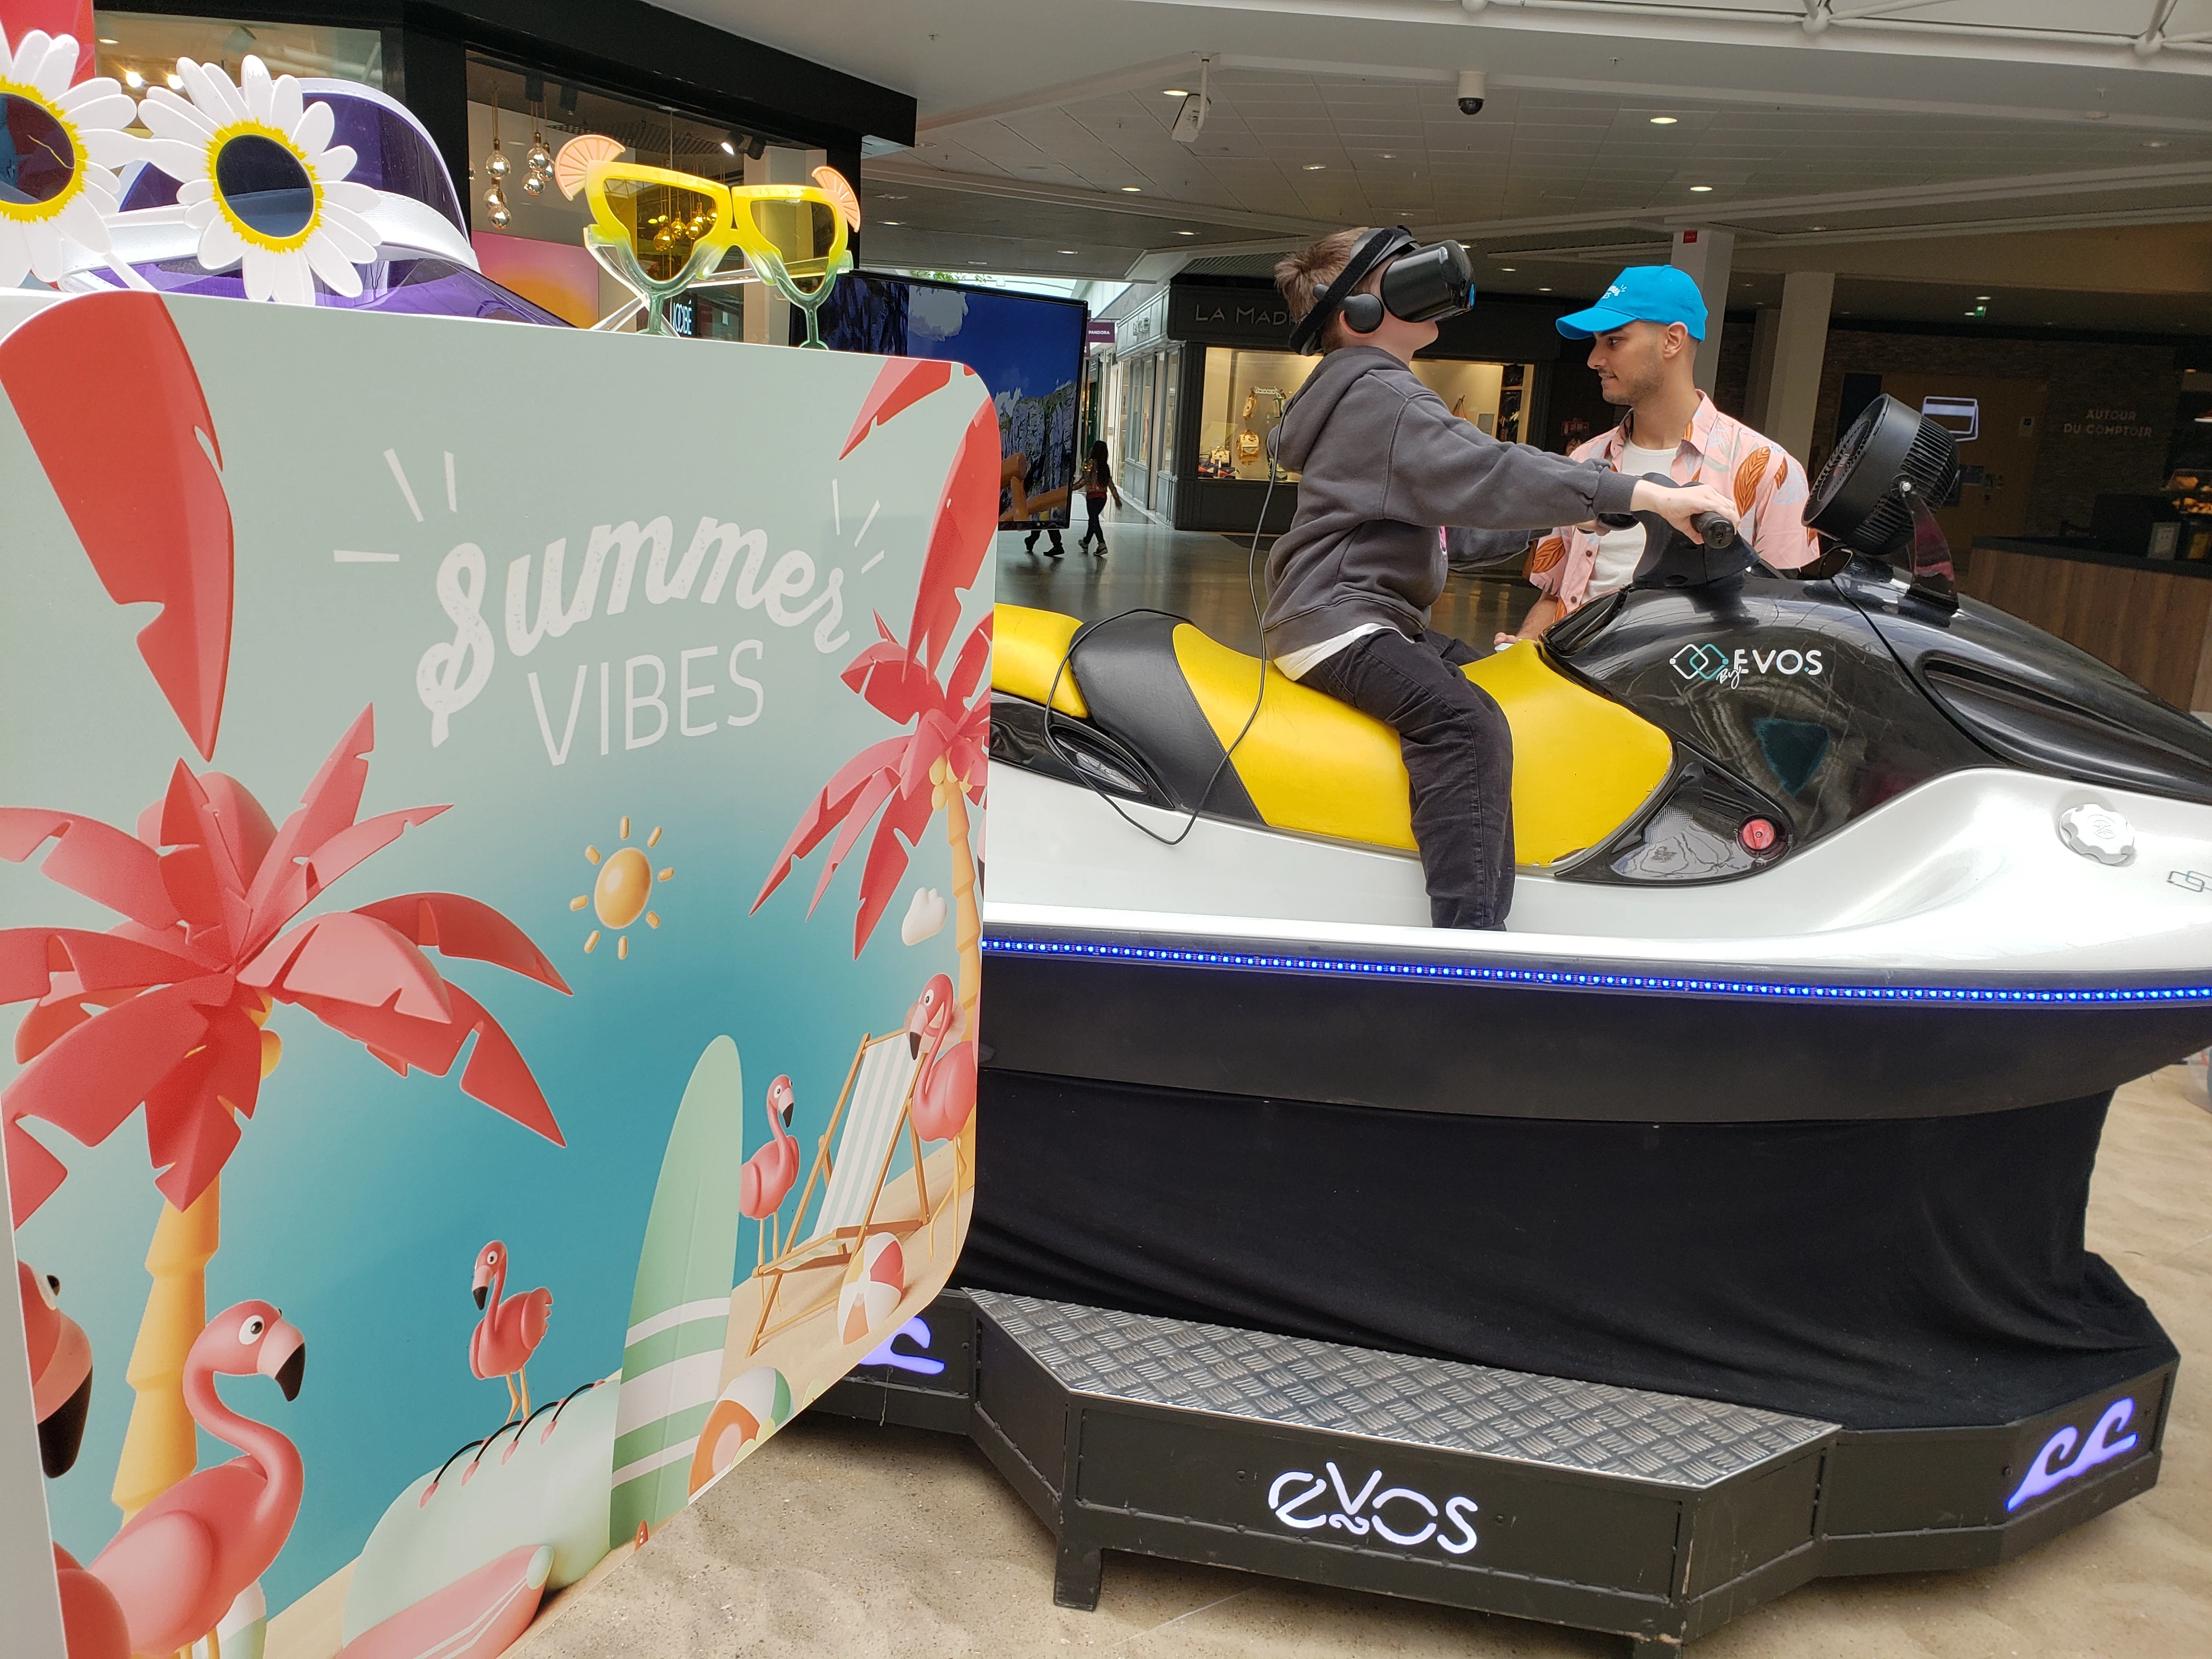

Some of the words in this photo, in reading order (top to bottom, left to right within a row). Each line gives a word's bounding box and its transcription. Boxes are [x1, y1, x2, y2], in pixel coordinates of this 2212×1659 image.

[1195, 304, 1225, 322] LA
[2086, 409, 2137, 421] AUTOUR
[2063, 423, 2081, 434] DU
[2086, 424, 2152, 437] COMPTOIR
[415, 515, 851, 748] Summer
[1733, 648, 1823, 675] EVOS
[527, 638, 764, 766] VIBES
